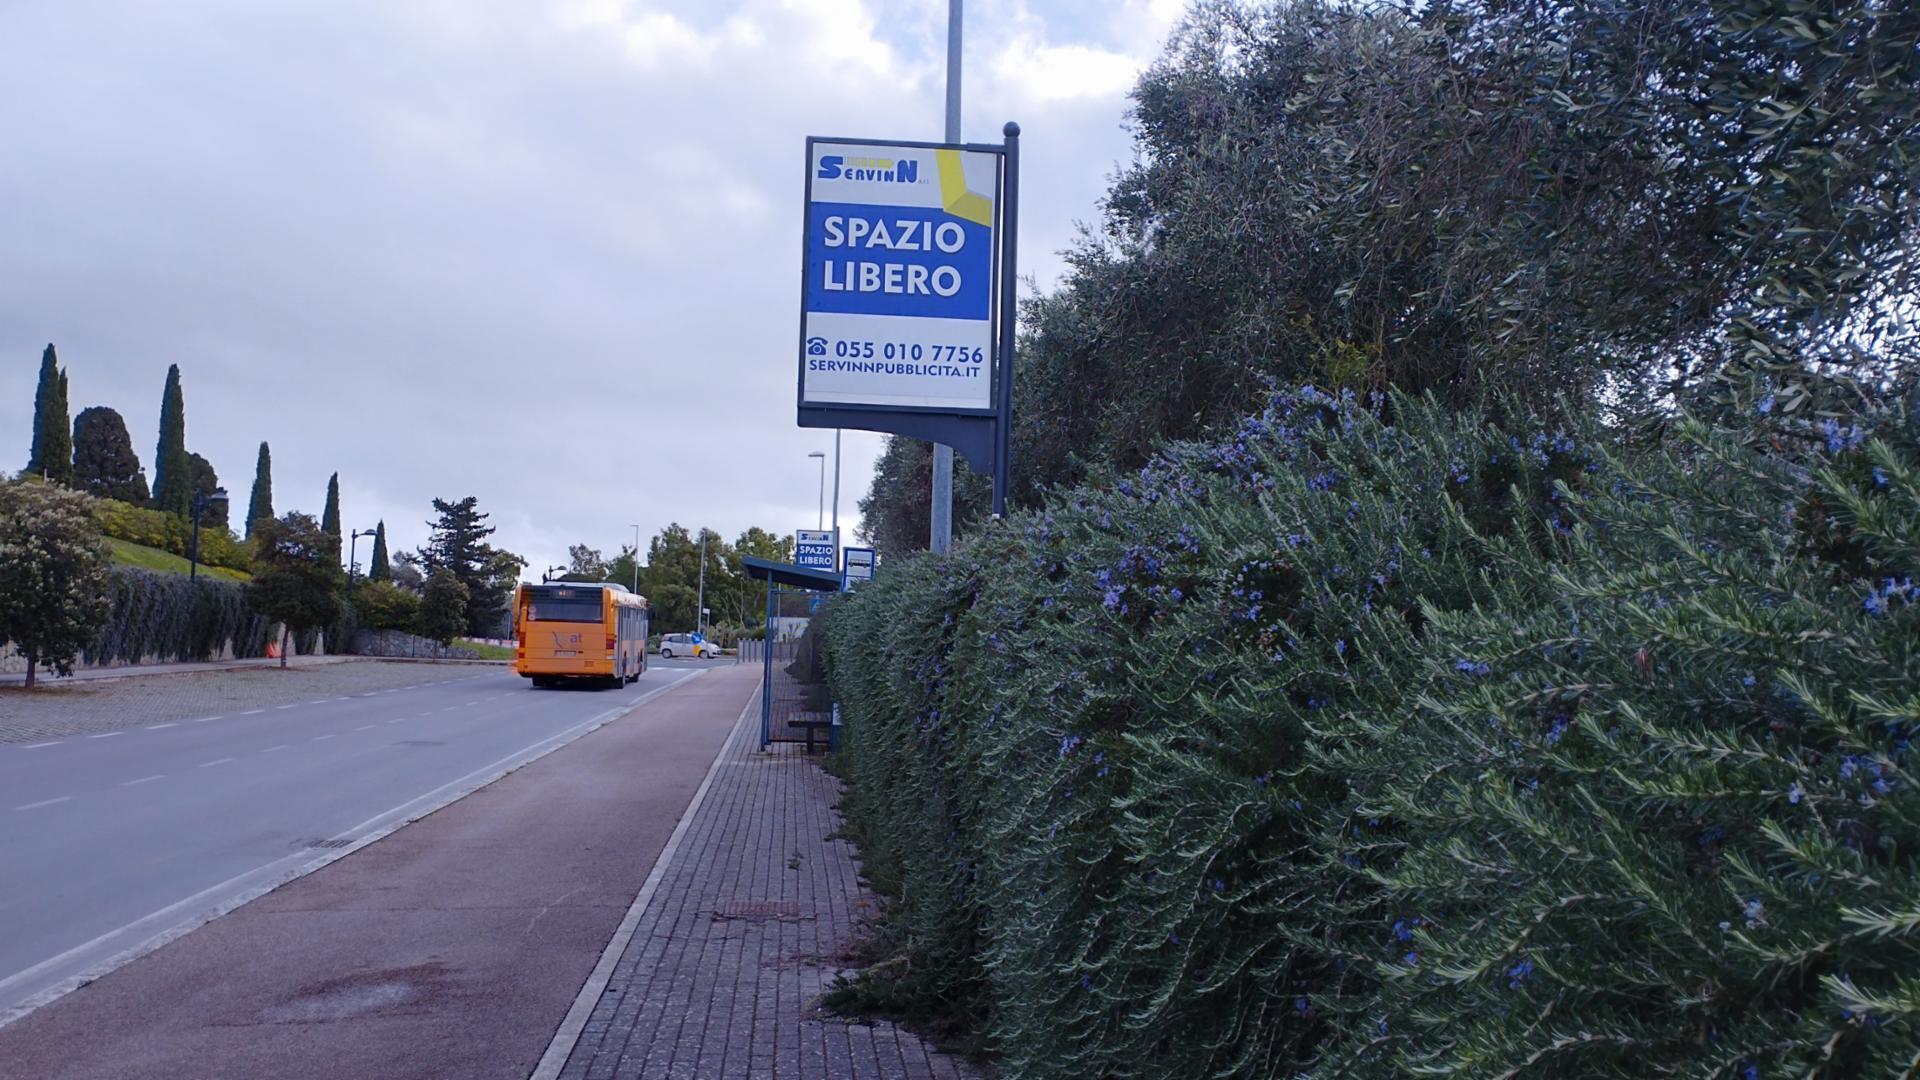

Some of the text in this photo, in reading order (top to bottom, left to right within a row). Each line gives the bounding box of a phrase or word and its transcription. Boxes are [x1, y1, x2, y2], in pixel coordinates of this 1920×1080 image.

[824, 216, 965, 253] SPAZIO
[824, 260, 961, 296] LIBERO
[835, 340, 983, 364] 055 010 7756
[809, 360, 980, 377] SERVINNPUBBLICITA.IT
[800, 545, 833, 555] SPAZIO
[800, 556, 832, 565] LIBERO
